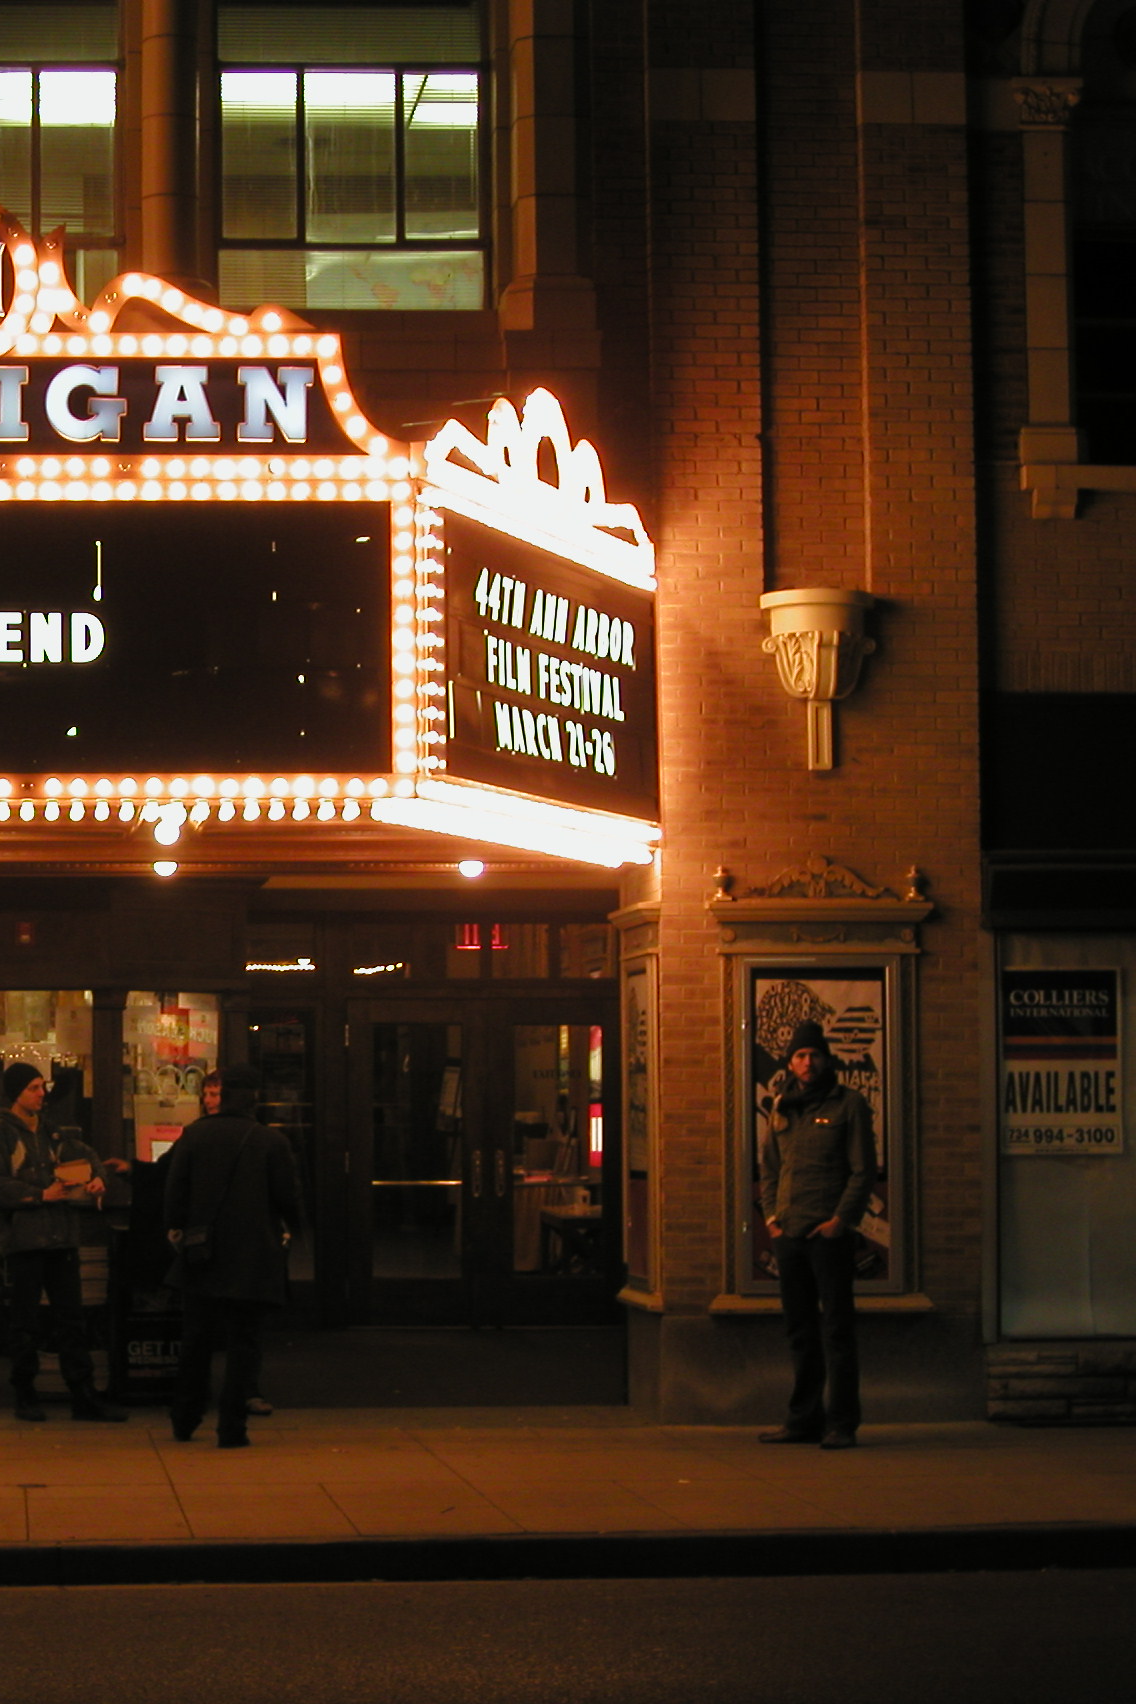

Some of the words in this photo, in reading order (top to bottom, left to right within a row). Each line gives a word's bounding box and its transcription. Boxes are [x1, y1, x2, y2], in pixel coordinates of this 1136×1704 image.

[475, 567, 526, 629] 44TH
[529, 588, 569, 644] ANN
[572, 605, 635, 666] ARBOR
[487, 635, 532, 695] FILM
[538, 652, 625, 722] FESTIVAL
[494, 701, 563, 762] MARCH
[565, 720, 616, 776] 21-26
[1008, 988, 1110, 1007] COLLIERS
[1008, 1007, 1110, 1018] INTERNATIONAL
[1004, 1070, 1116, 1114] AVAILABLE
[1008, 1129, 1030, 1142] 734
[1033, 1128, 1115, 1144] 994-3100
[127, 1340, 164, 1356] GET
